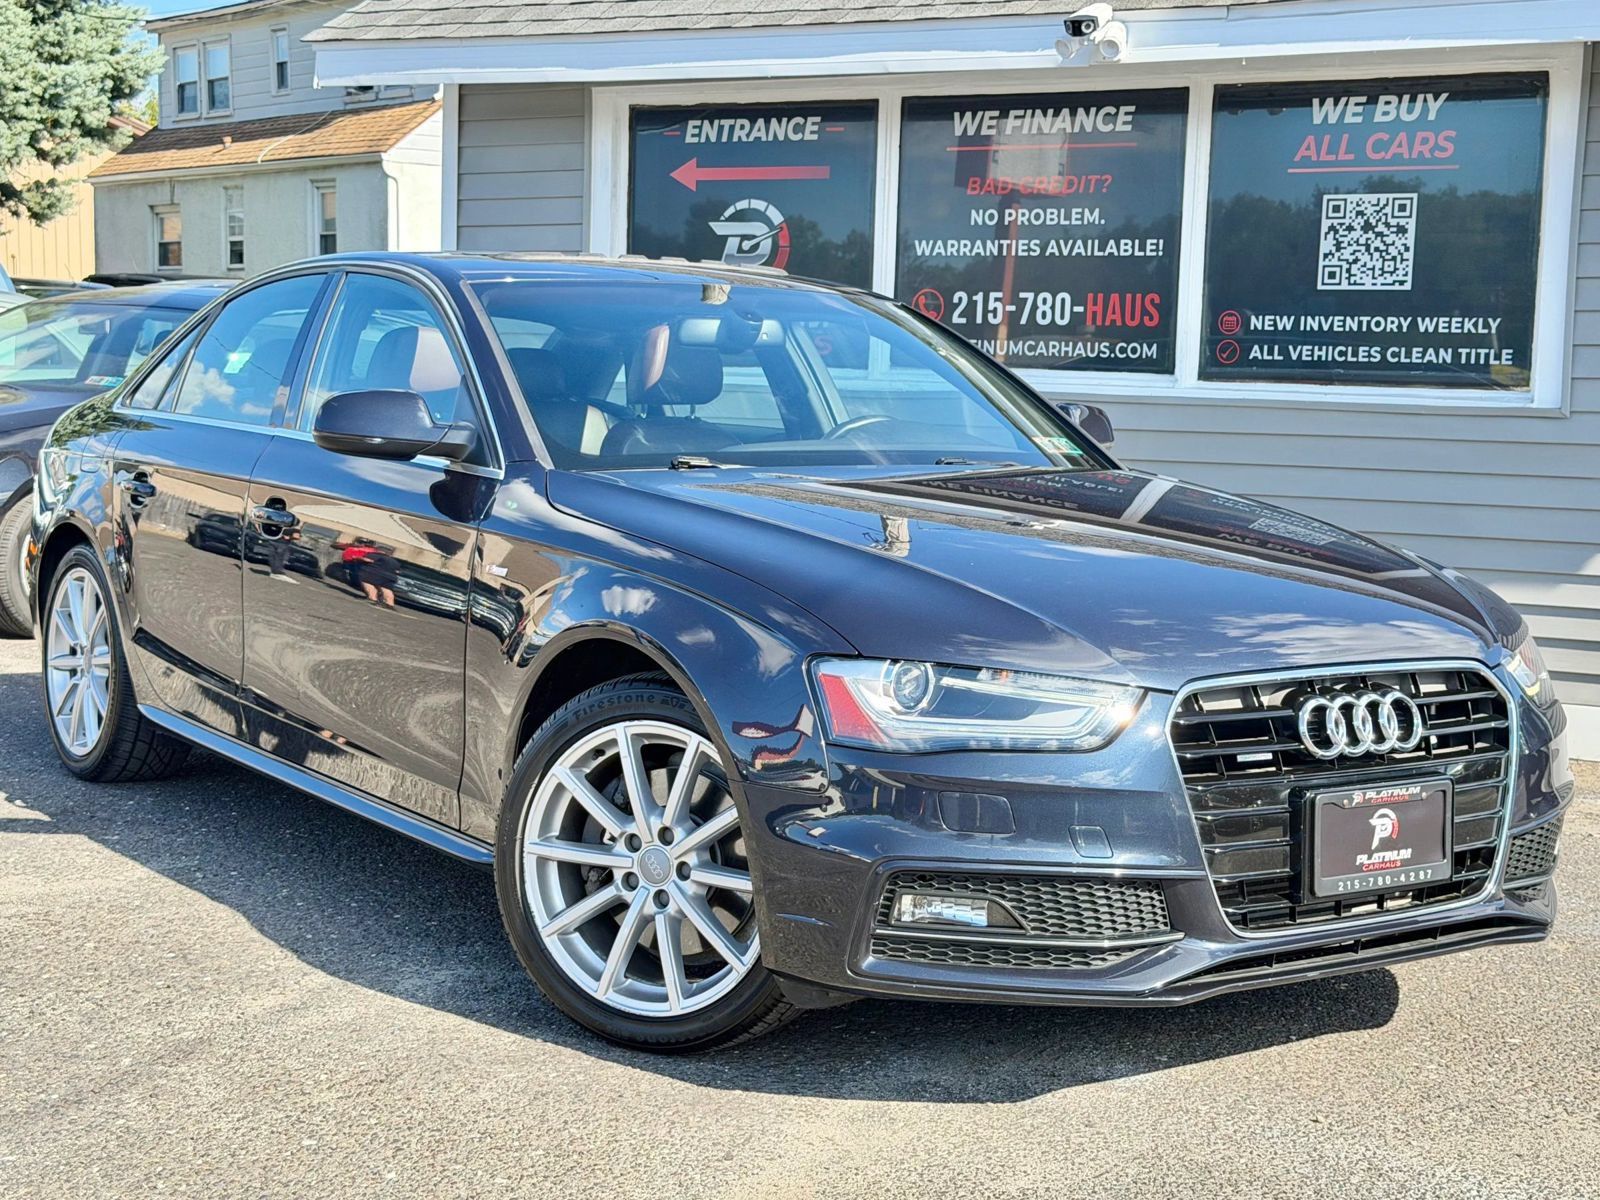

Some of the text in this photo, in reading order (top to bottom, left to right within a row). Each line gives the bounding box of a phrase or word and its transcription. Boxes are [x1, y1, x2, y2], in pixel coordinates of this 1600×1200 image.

[1311, 92, 1450, 125] WE BUY
[684, 116, 822, 144] ENTRANCE
[953, 105, 1137, 137] WE FINANCE
[1293, 130, 1457, 162] ALL CARS
[966, 174, 1113, 196] BAD CREDIT?
[970, 207, 1106, 226] NO PROBLEM.
[914, 239, 1164, 257] WARRANTIES AVAILABLE!
[951, 290, 1161, 327] 215-780-HAUS
[1249, 314, 1502, 334] NEW INVENTORY WEEKLY
[1248, 344, 1514, 366] ALL VEHICLES CLEAN TITLE
[571, 693, 656, 721] Firestone
[1365, 786, 1421, 799] PLATINUM
[1355, 848, 1412, 865] PLATINUM
[1362, 860, 1401, 871] CARHAUS
